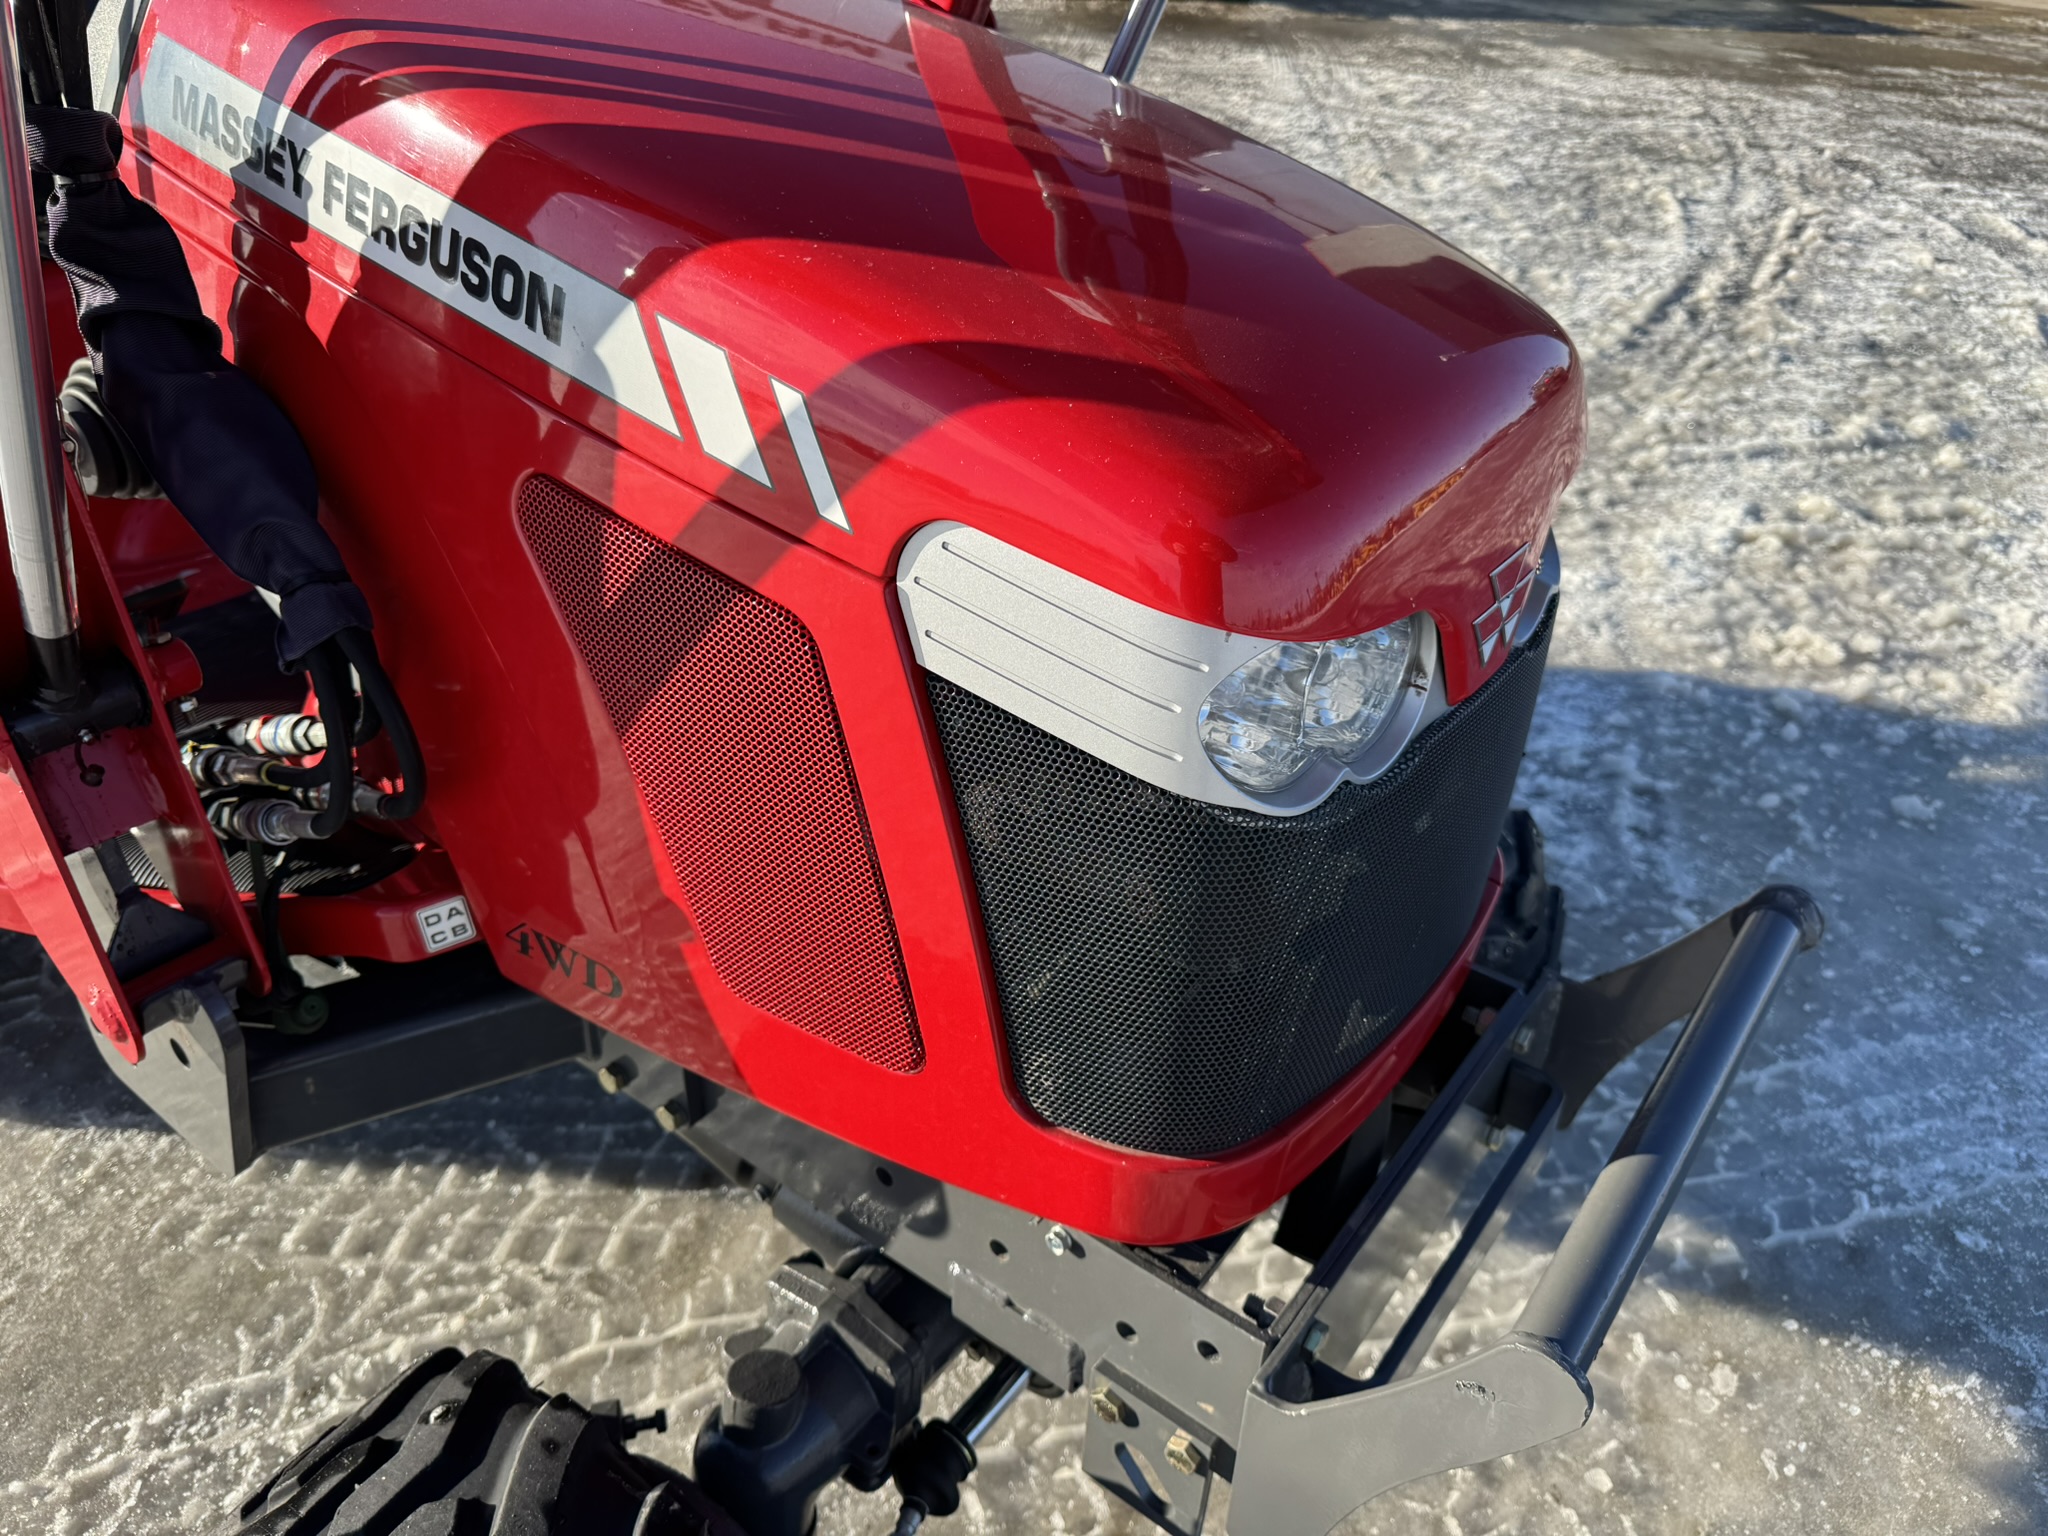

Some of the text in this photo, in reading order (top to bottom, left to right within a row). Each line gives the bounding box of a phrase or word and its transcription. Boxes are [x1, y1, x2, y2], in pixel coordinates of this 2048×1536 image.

[171, 74, 566, 346] MASSEY FERGUSON
[505, 921, 623, 999] 4WD
